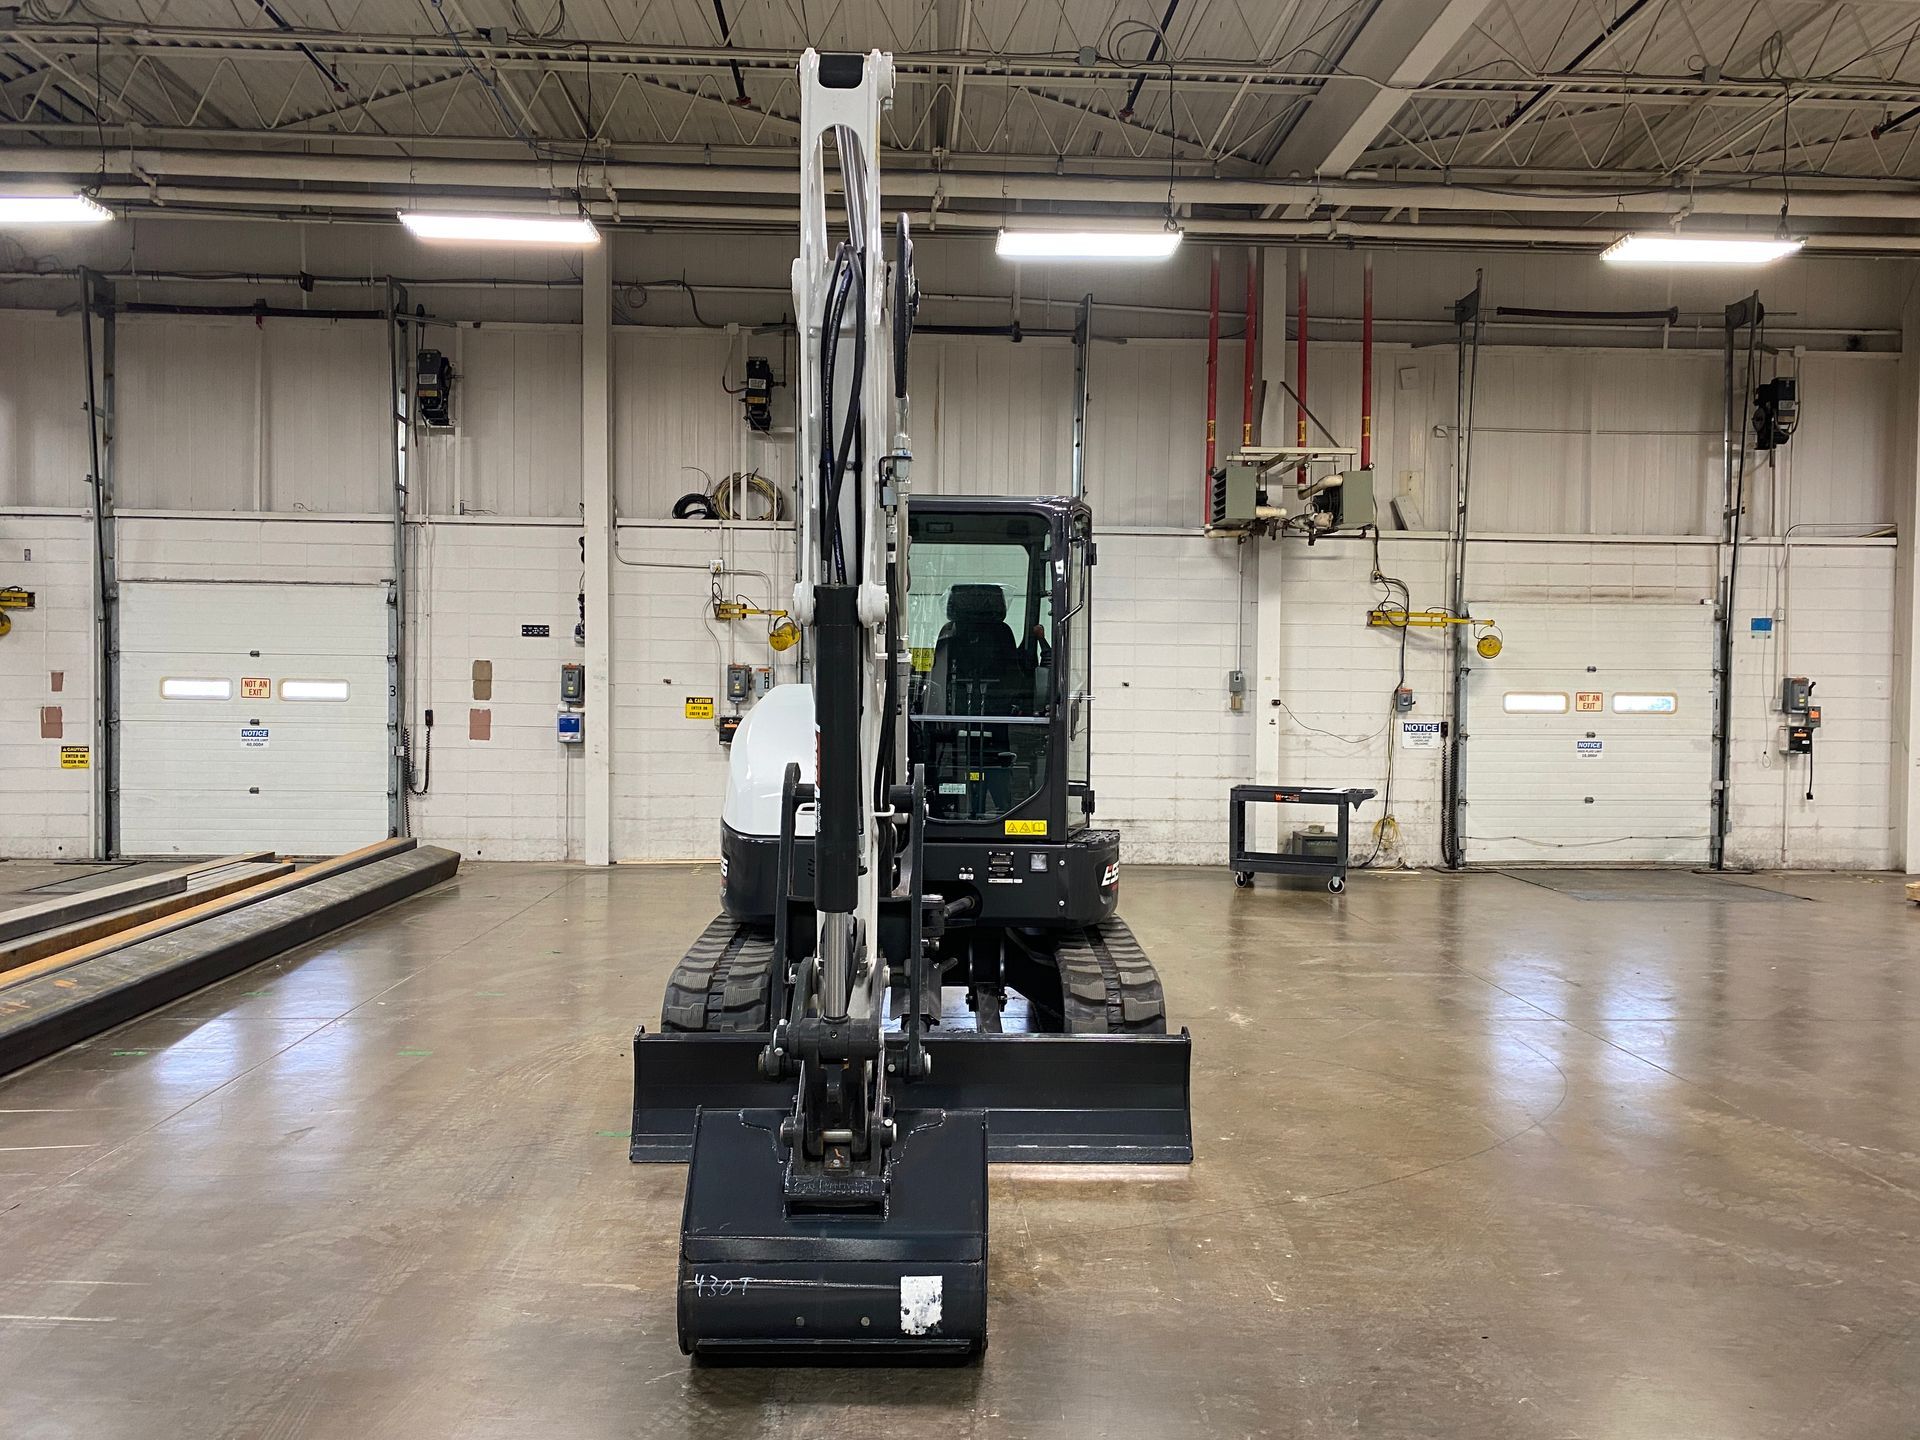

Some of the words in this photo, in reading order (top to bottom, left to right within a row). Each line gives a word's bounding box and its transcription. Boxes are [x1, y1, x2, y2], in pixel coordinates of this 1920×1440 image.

[244, 680, 256, 688] NOT
[259, 680, 267, 688] AN
[248, 688, 262, 696] EXIT
[389, 685, 396, 697] 3
[1578, 694, 1590, 702] NOT
[1592, 694, 1600, 702] AN
[1582, 702, 1595, 710] EXIT
[1404, 724, 1438, 732] NOTICE
[694, 1273, 757, 1297] 430T
